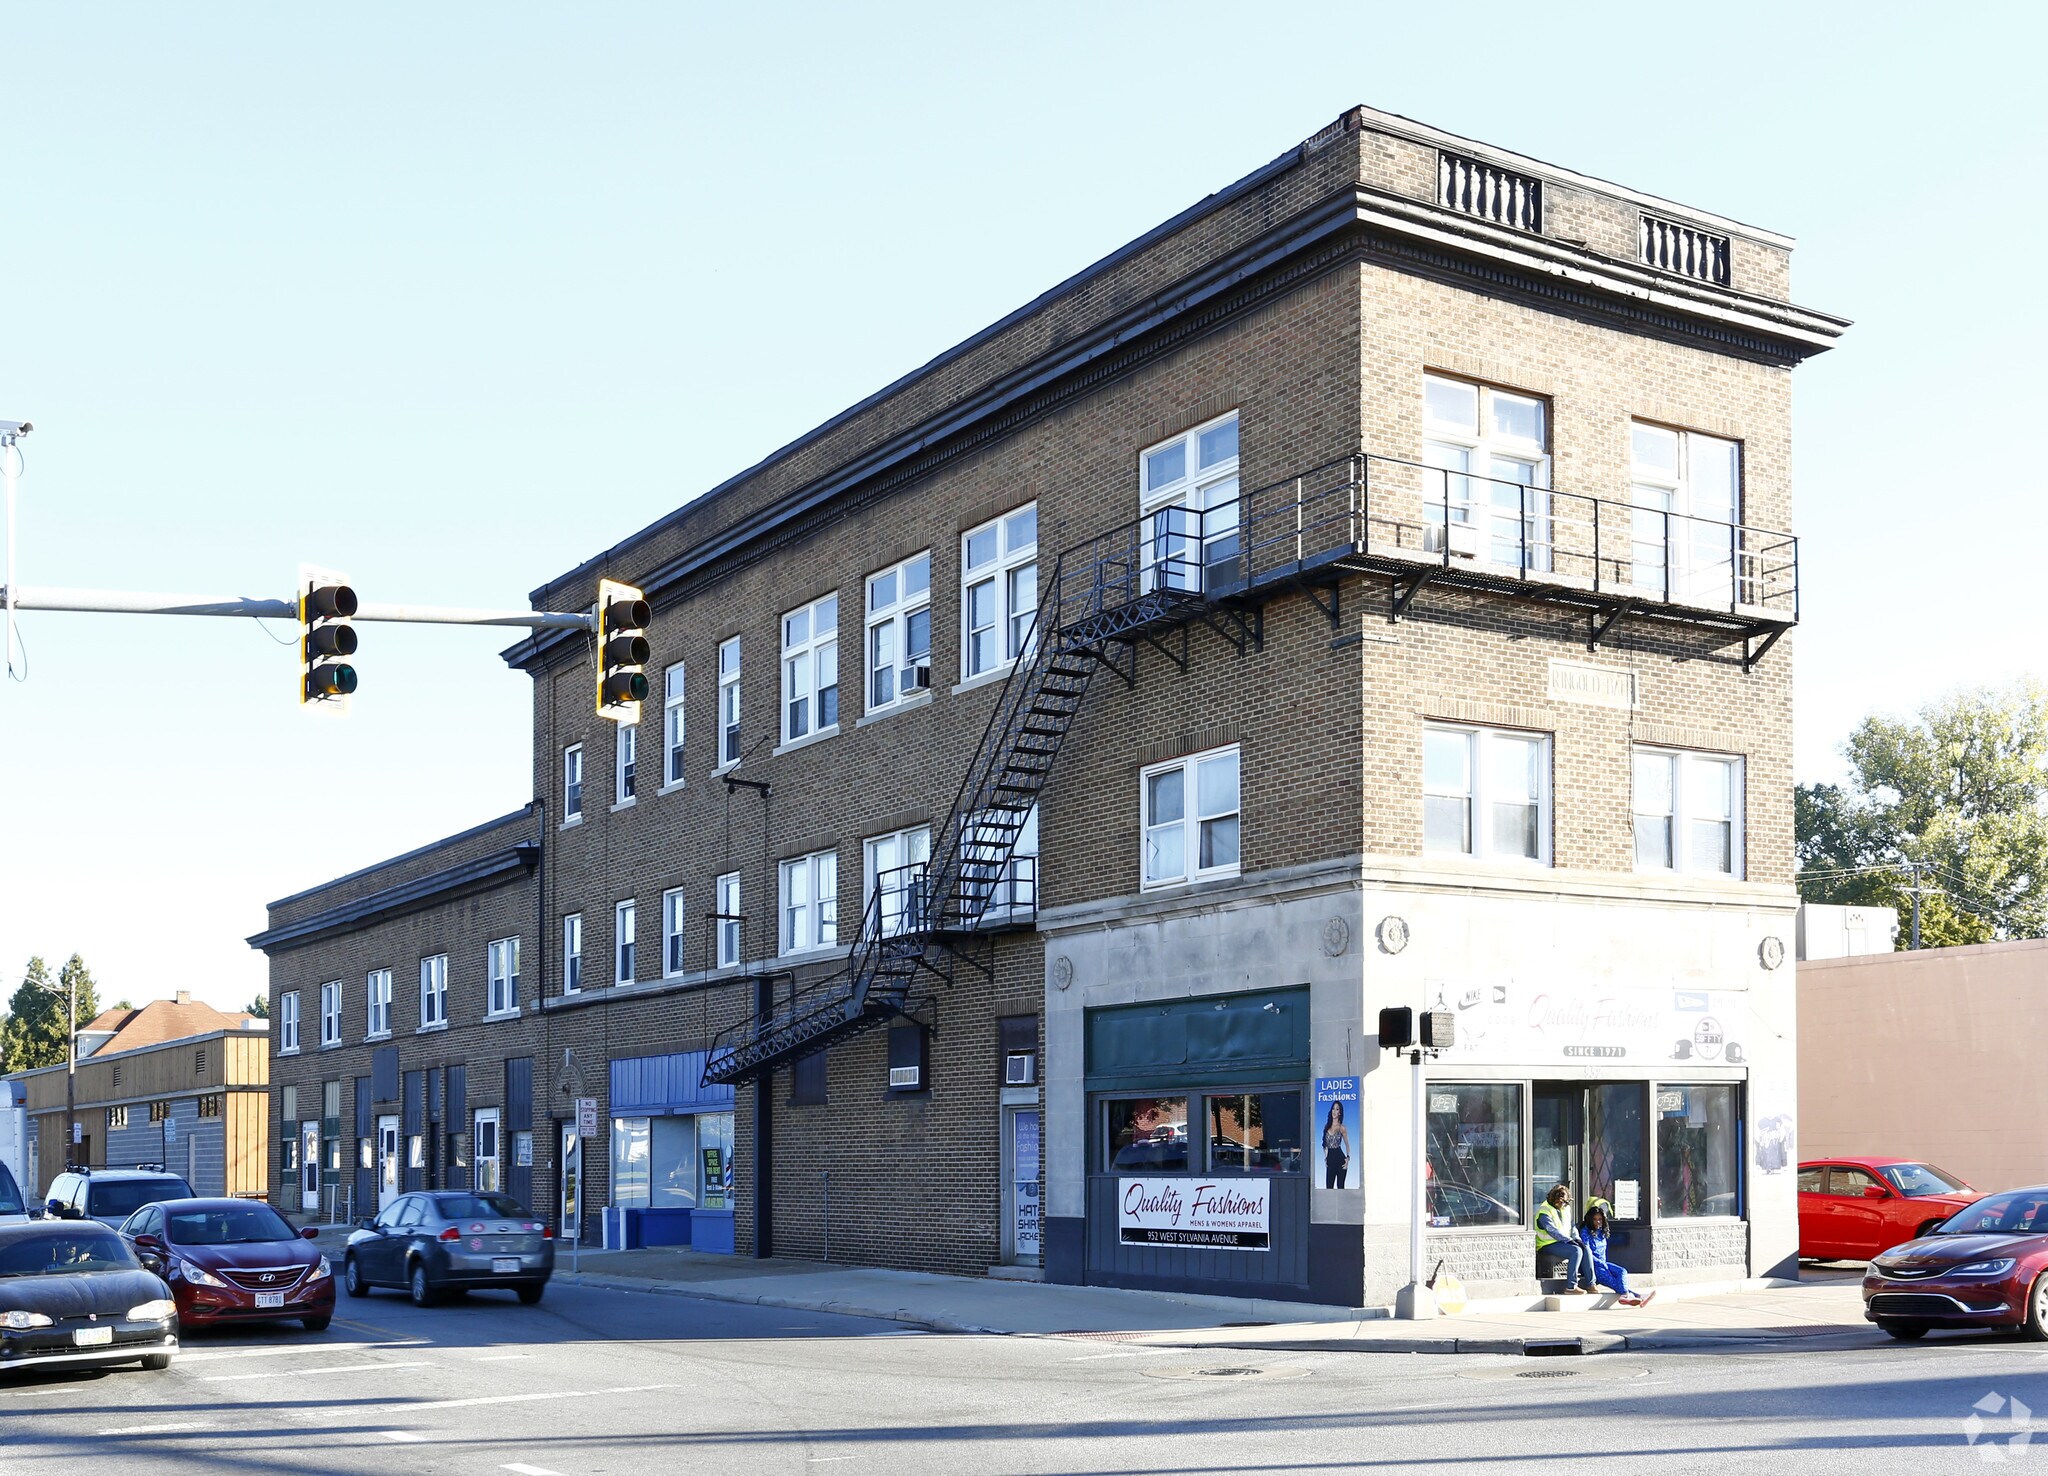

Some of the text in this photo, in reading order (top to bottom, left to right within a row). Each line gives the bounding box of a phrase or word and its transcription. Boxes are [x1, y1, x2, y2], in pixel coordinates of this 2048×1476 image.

[1552, 669, 1600, 693] RINGOLD
[1464, 987, 1482, 1003] NIKE
[1528, 994, 1660, 1041] Quality Fashions
[1568, 1046, 1622, 1057] SINCE 1971
[1321, 1080, 1353, 1090] LADIES
[1318, 1091, 1357, 1101] Fashions
[1432, 1096, 1457, 1109] OPEN
[1657, 1096, 1681, 1108] OPEN
[1019, 1204, 1040, 1217] HAT
[1124, 1183, 1264, 1226] Quality Fashions
[1238, 1221, 1263, 1229] APPAREL
[1147, 1231, 1239, 1245] 952 WEST SYLVANIA AVENUE
